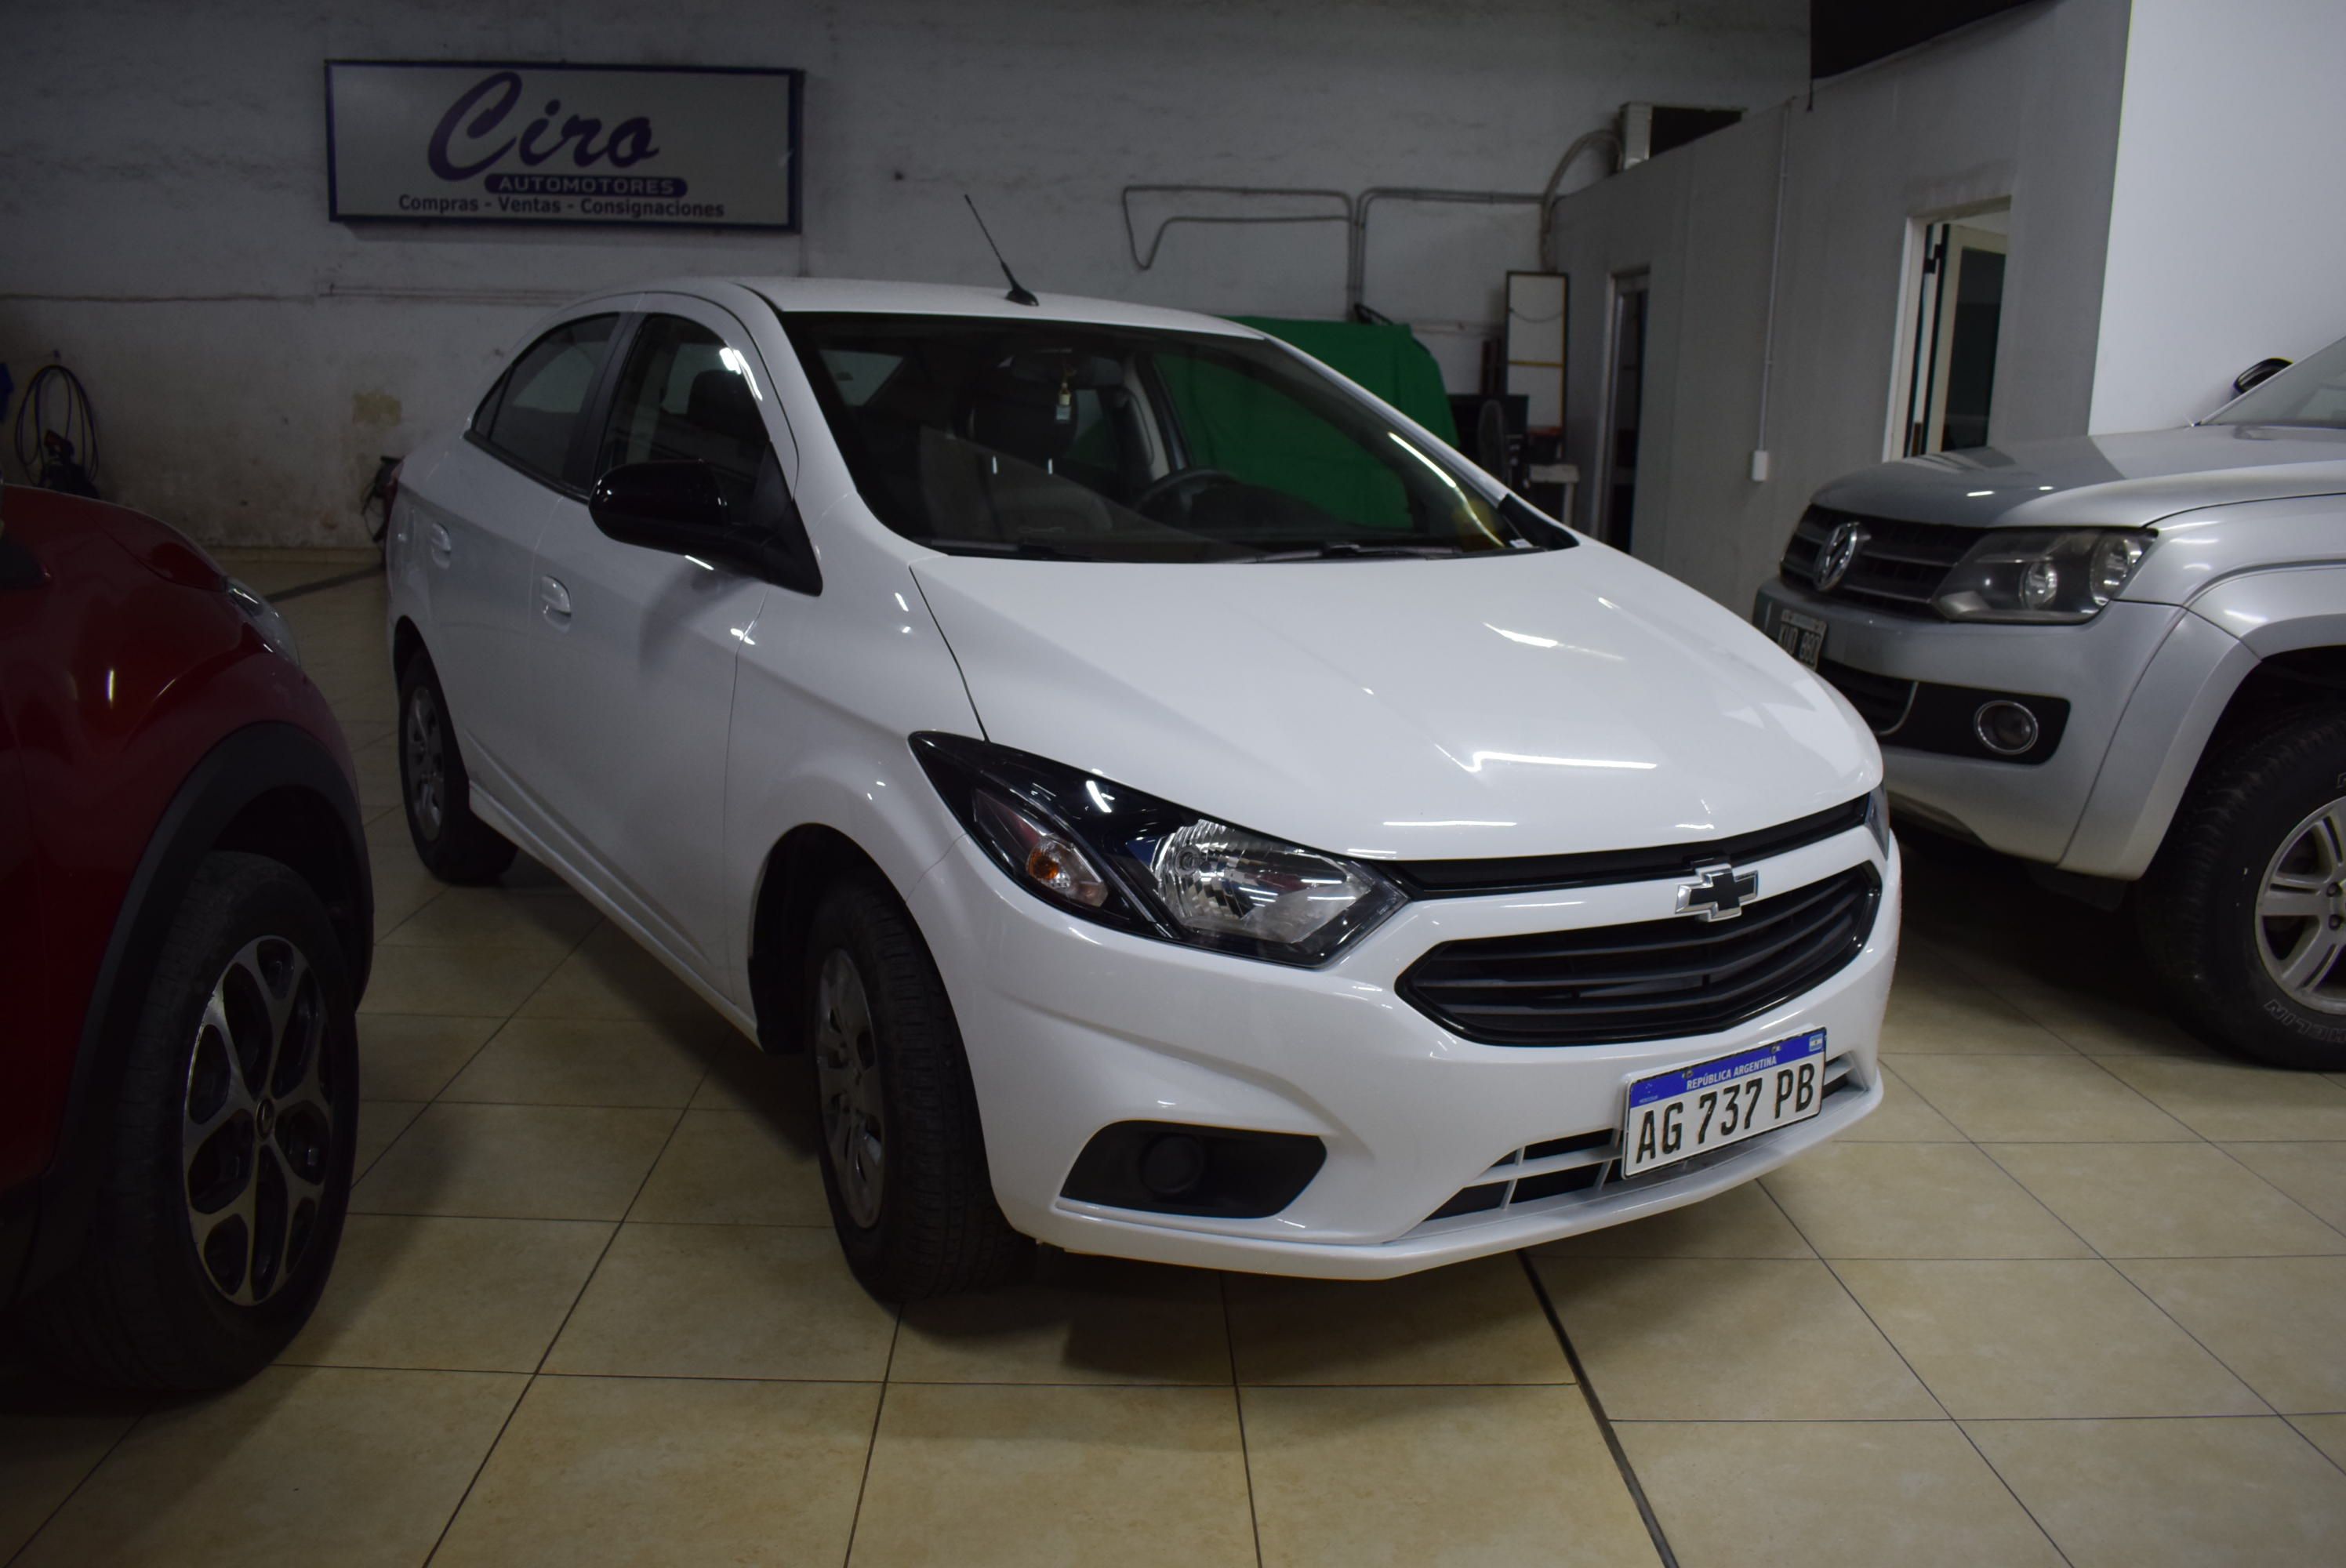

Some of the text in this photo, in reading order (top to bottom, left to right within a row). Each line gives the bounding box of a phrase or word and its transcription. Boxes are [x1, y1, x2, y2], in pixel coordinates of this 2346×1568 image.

[428, 71, 659, 181] Ciro
[499, 176, 674, 194] AUTOMOTORES
[399, 194, 478, 213] Compras
[498, 195, 561, 212] Ventas
[581, 198, 724, 219] Consignaciones
[1687, 1055, 1777, 1091] REPÚBLICA ARGENTINA
[1636, 1063, 1815, 1164] AG 737 PB
